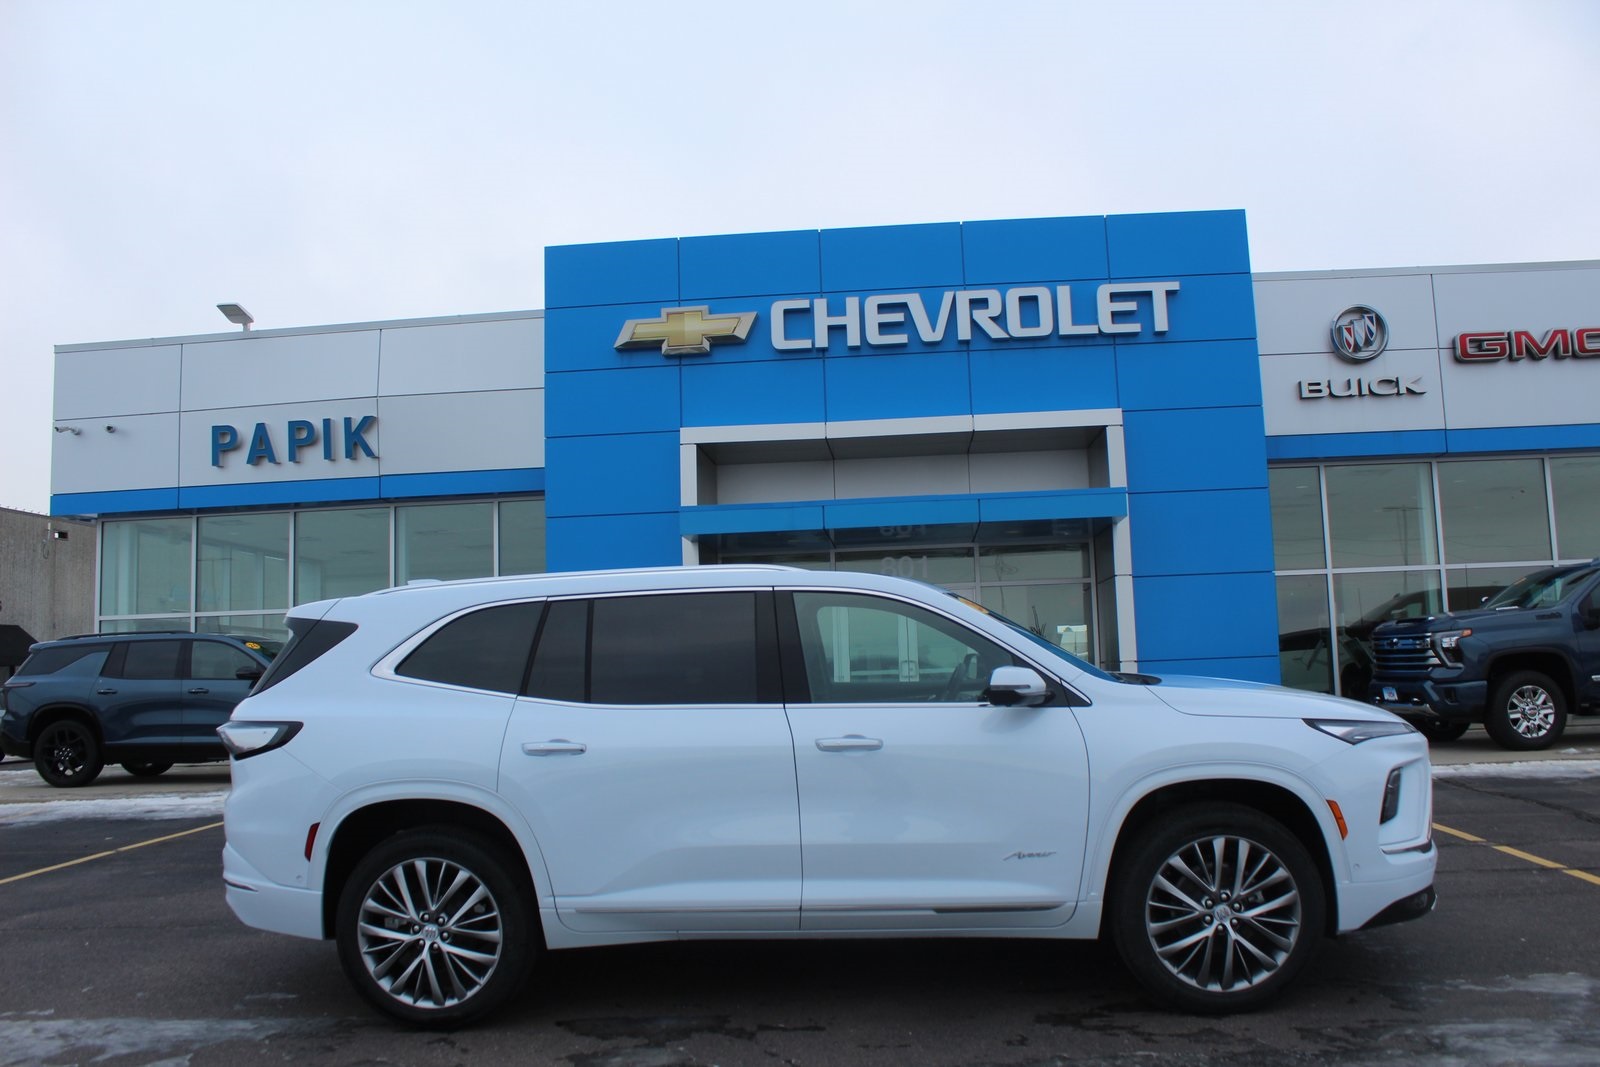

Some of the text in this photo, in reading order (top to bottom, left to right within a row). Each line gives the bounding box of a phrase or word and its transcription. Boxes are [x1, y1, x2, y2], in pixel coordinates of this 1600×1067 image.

[770, 281, 1181, 351] CHEVROLET
[1299, 377, 1427, 400] BUICK
[211, 415, 379, 468] PAPIK
[881, 555, 929, 579] 801
